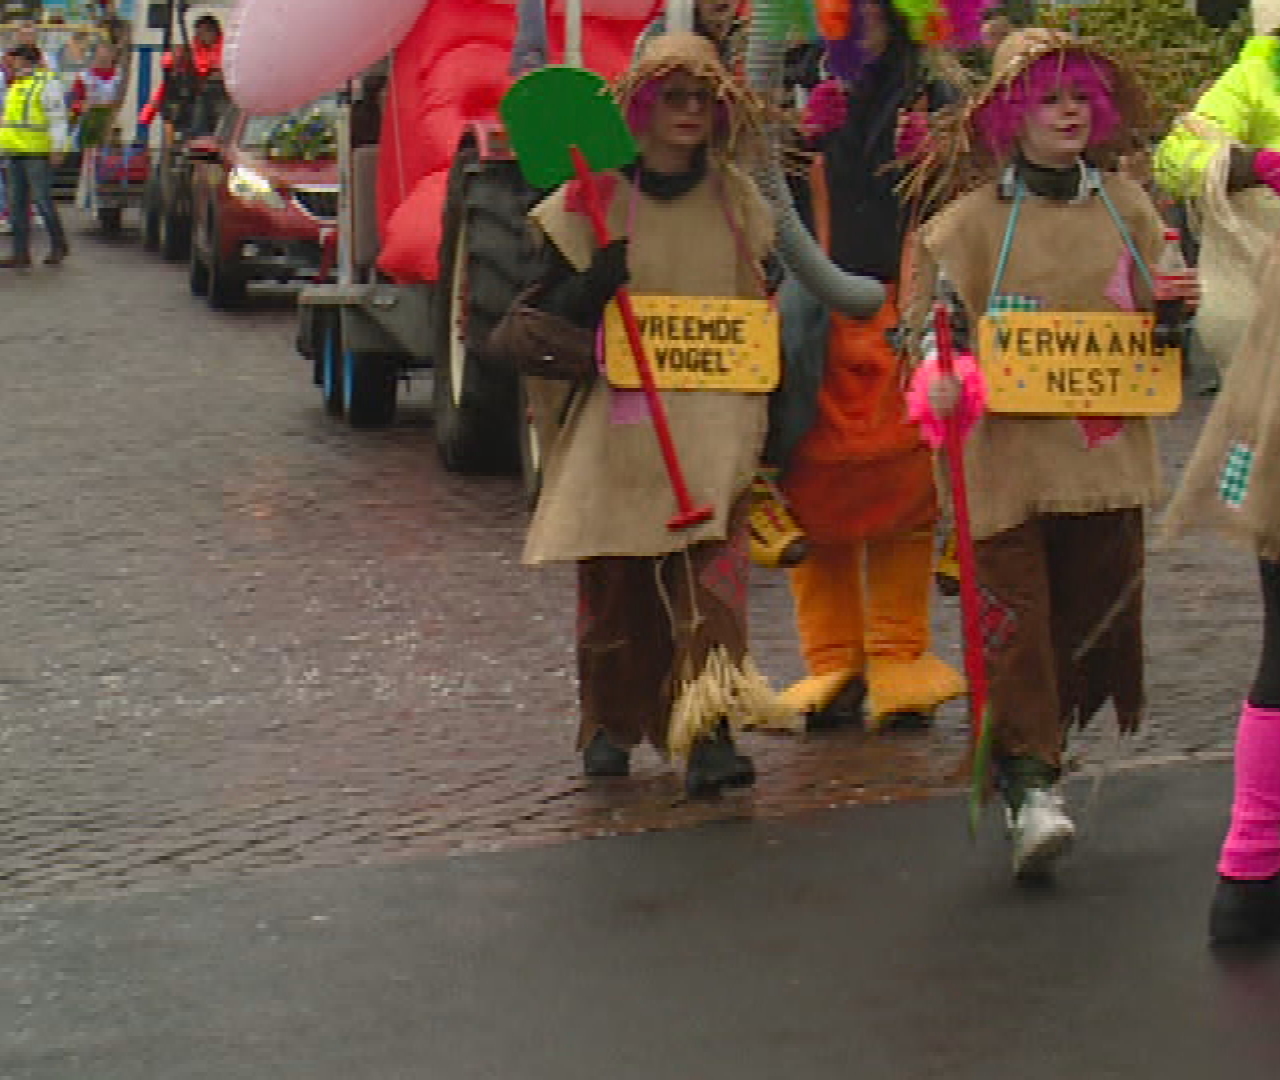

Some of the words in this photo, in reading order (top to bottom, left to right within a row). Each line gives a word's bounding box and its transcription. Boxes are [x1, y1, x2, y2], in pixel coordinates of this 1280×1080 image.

[994, 326, 1166, 358] VERWAAN
[655, 347, 730, 377] VOGEL
[1046, 367, 1122, 397] NEST
